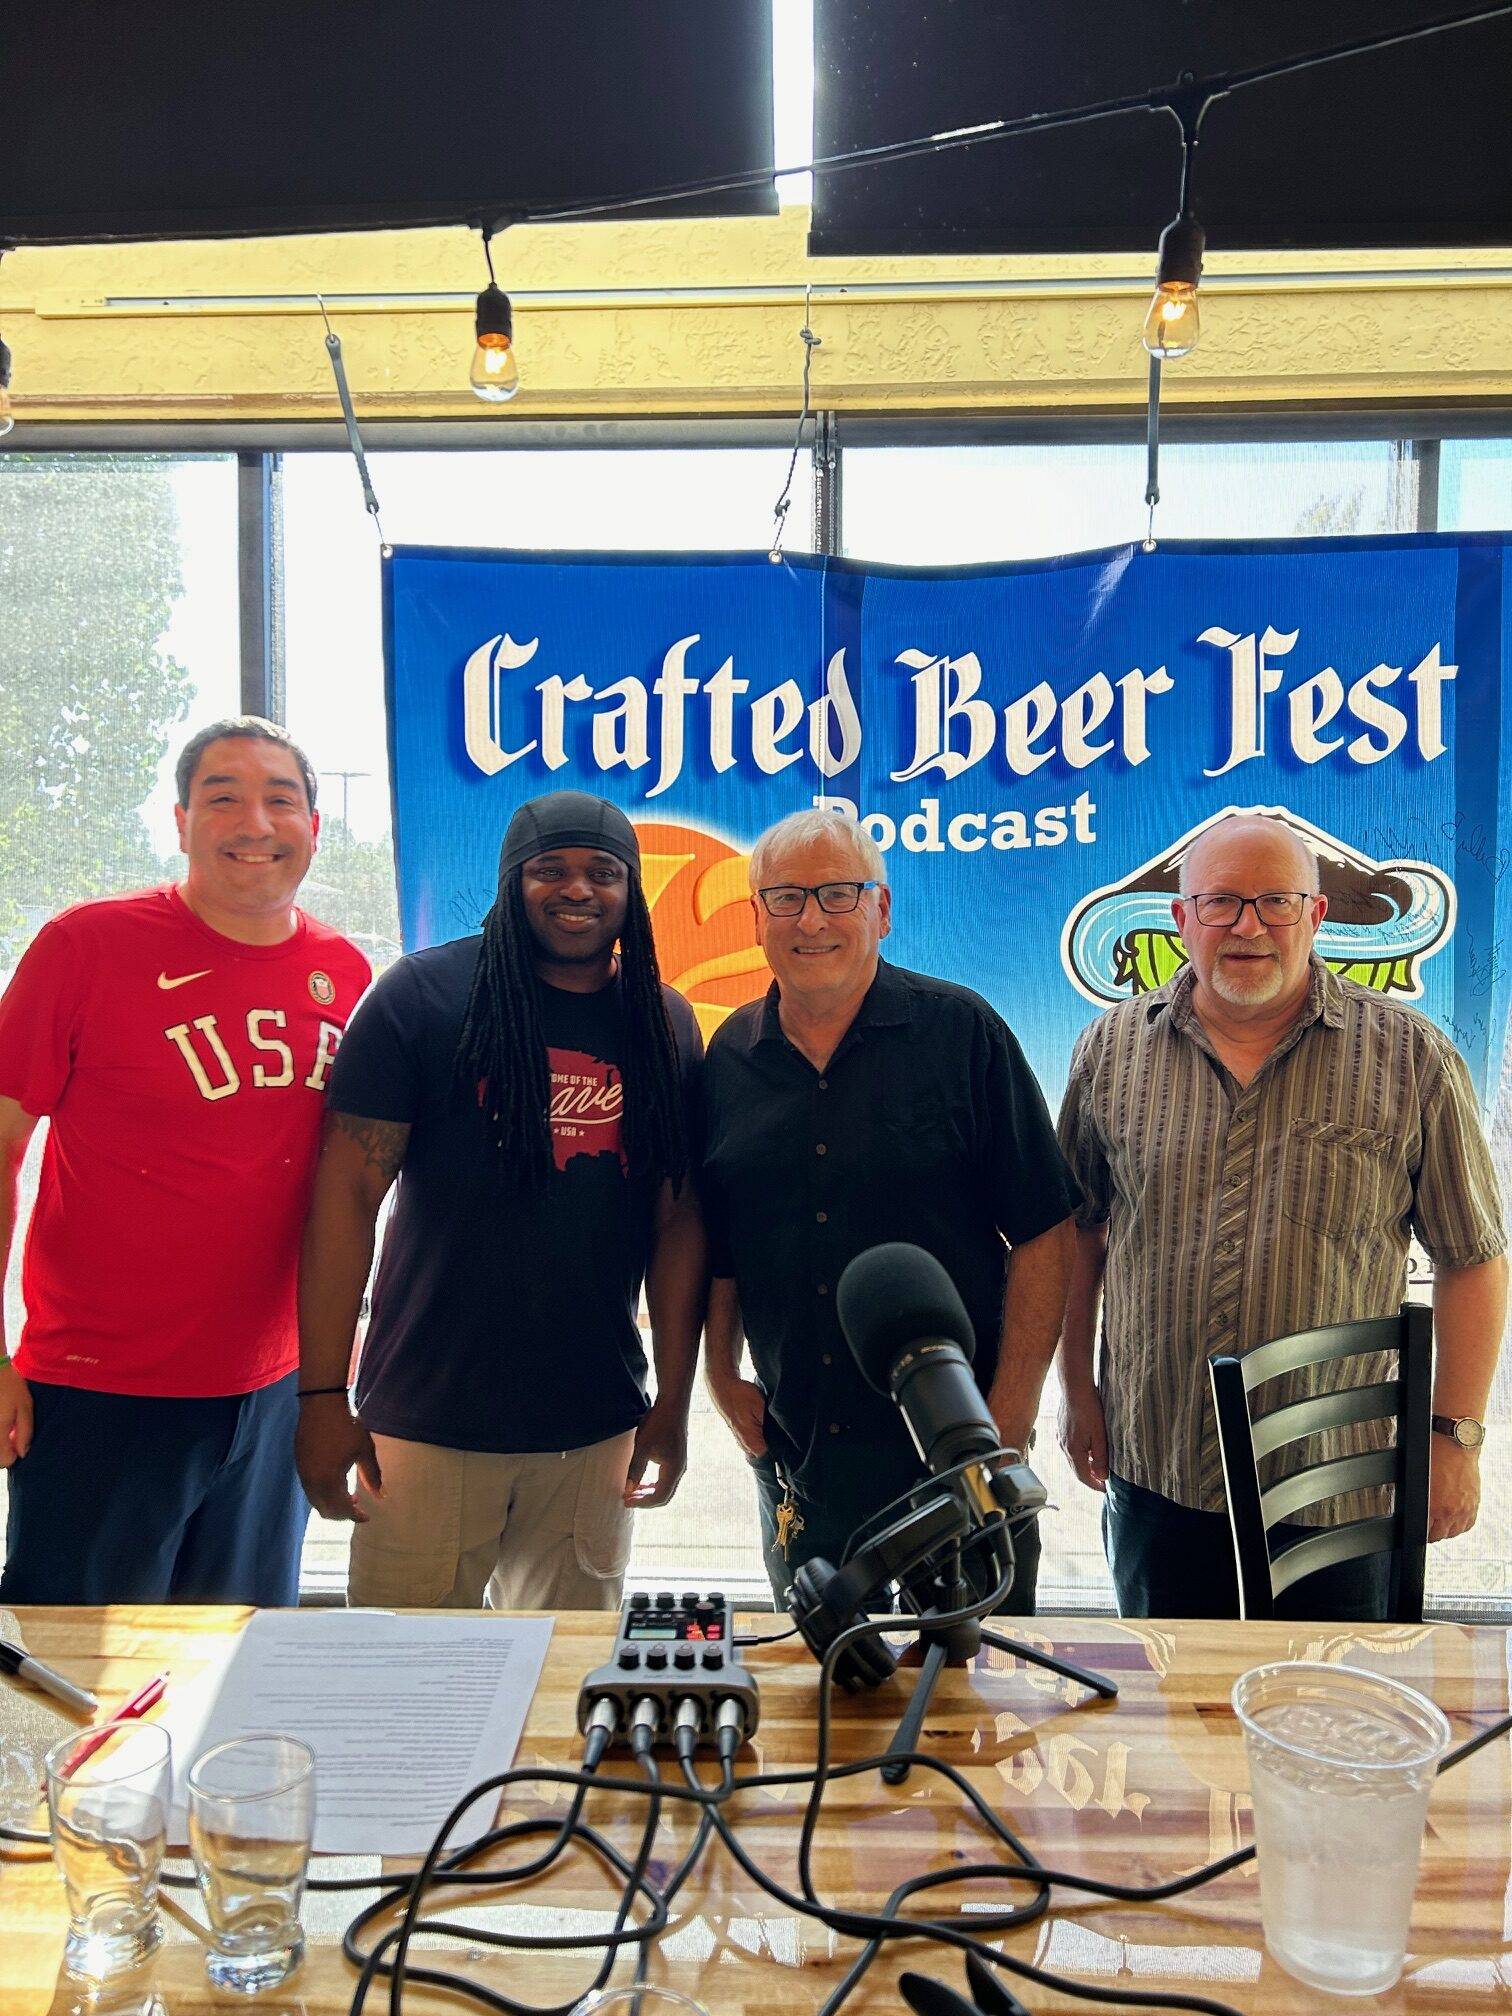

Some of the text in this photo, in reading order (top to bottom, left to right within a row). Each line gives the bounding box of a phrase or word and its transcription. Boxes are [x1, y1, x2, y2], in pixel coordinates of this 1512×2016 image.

[463, 625, 1459, 799] Crafted Beer Fest
[550, 1073, 598, 1087] OME OF THE
[550, 1083, 624, 1118] ave
[560, 1126, 577, 1137] USA
